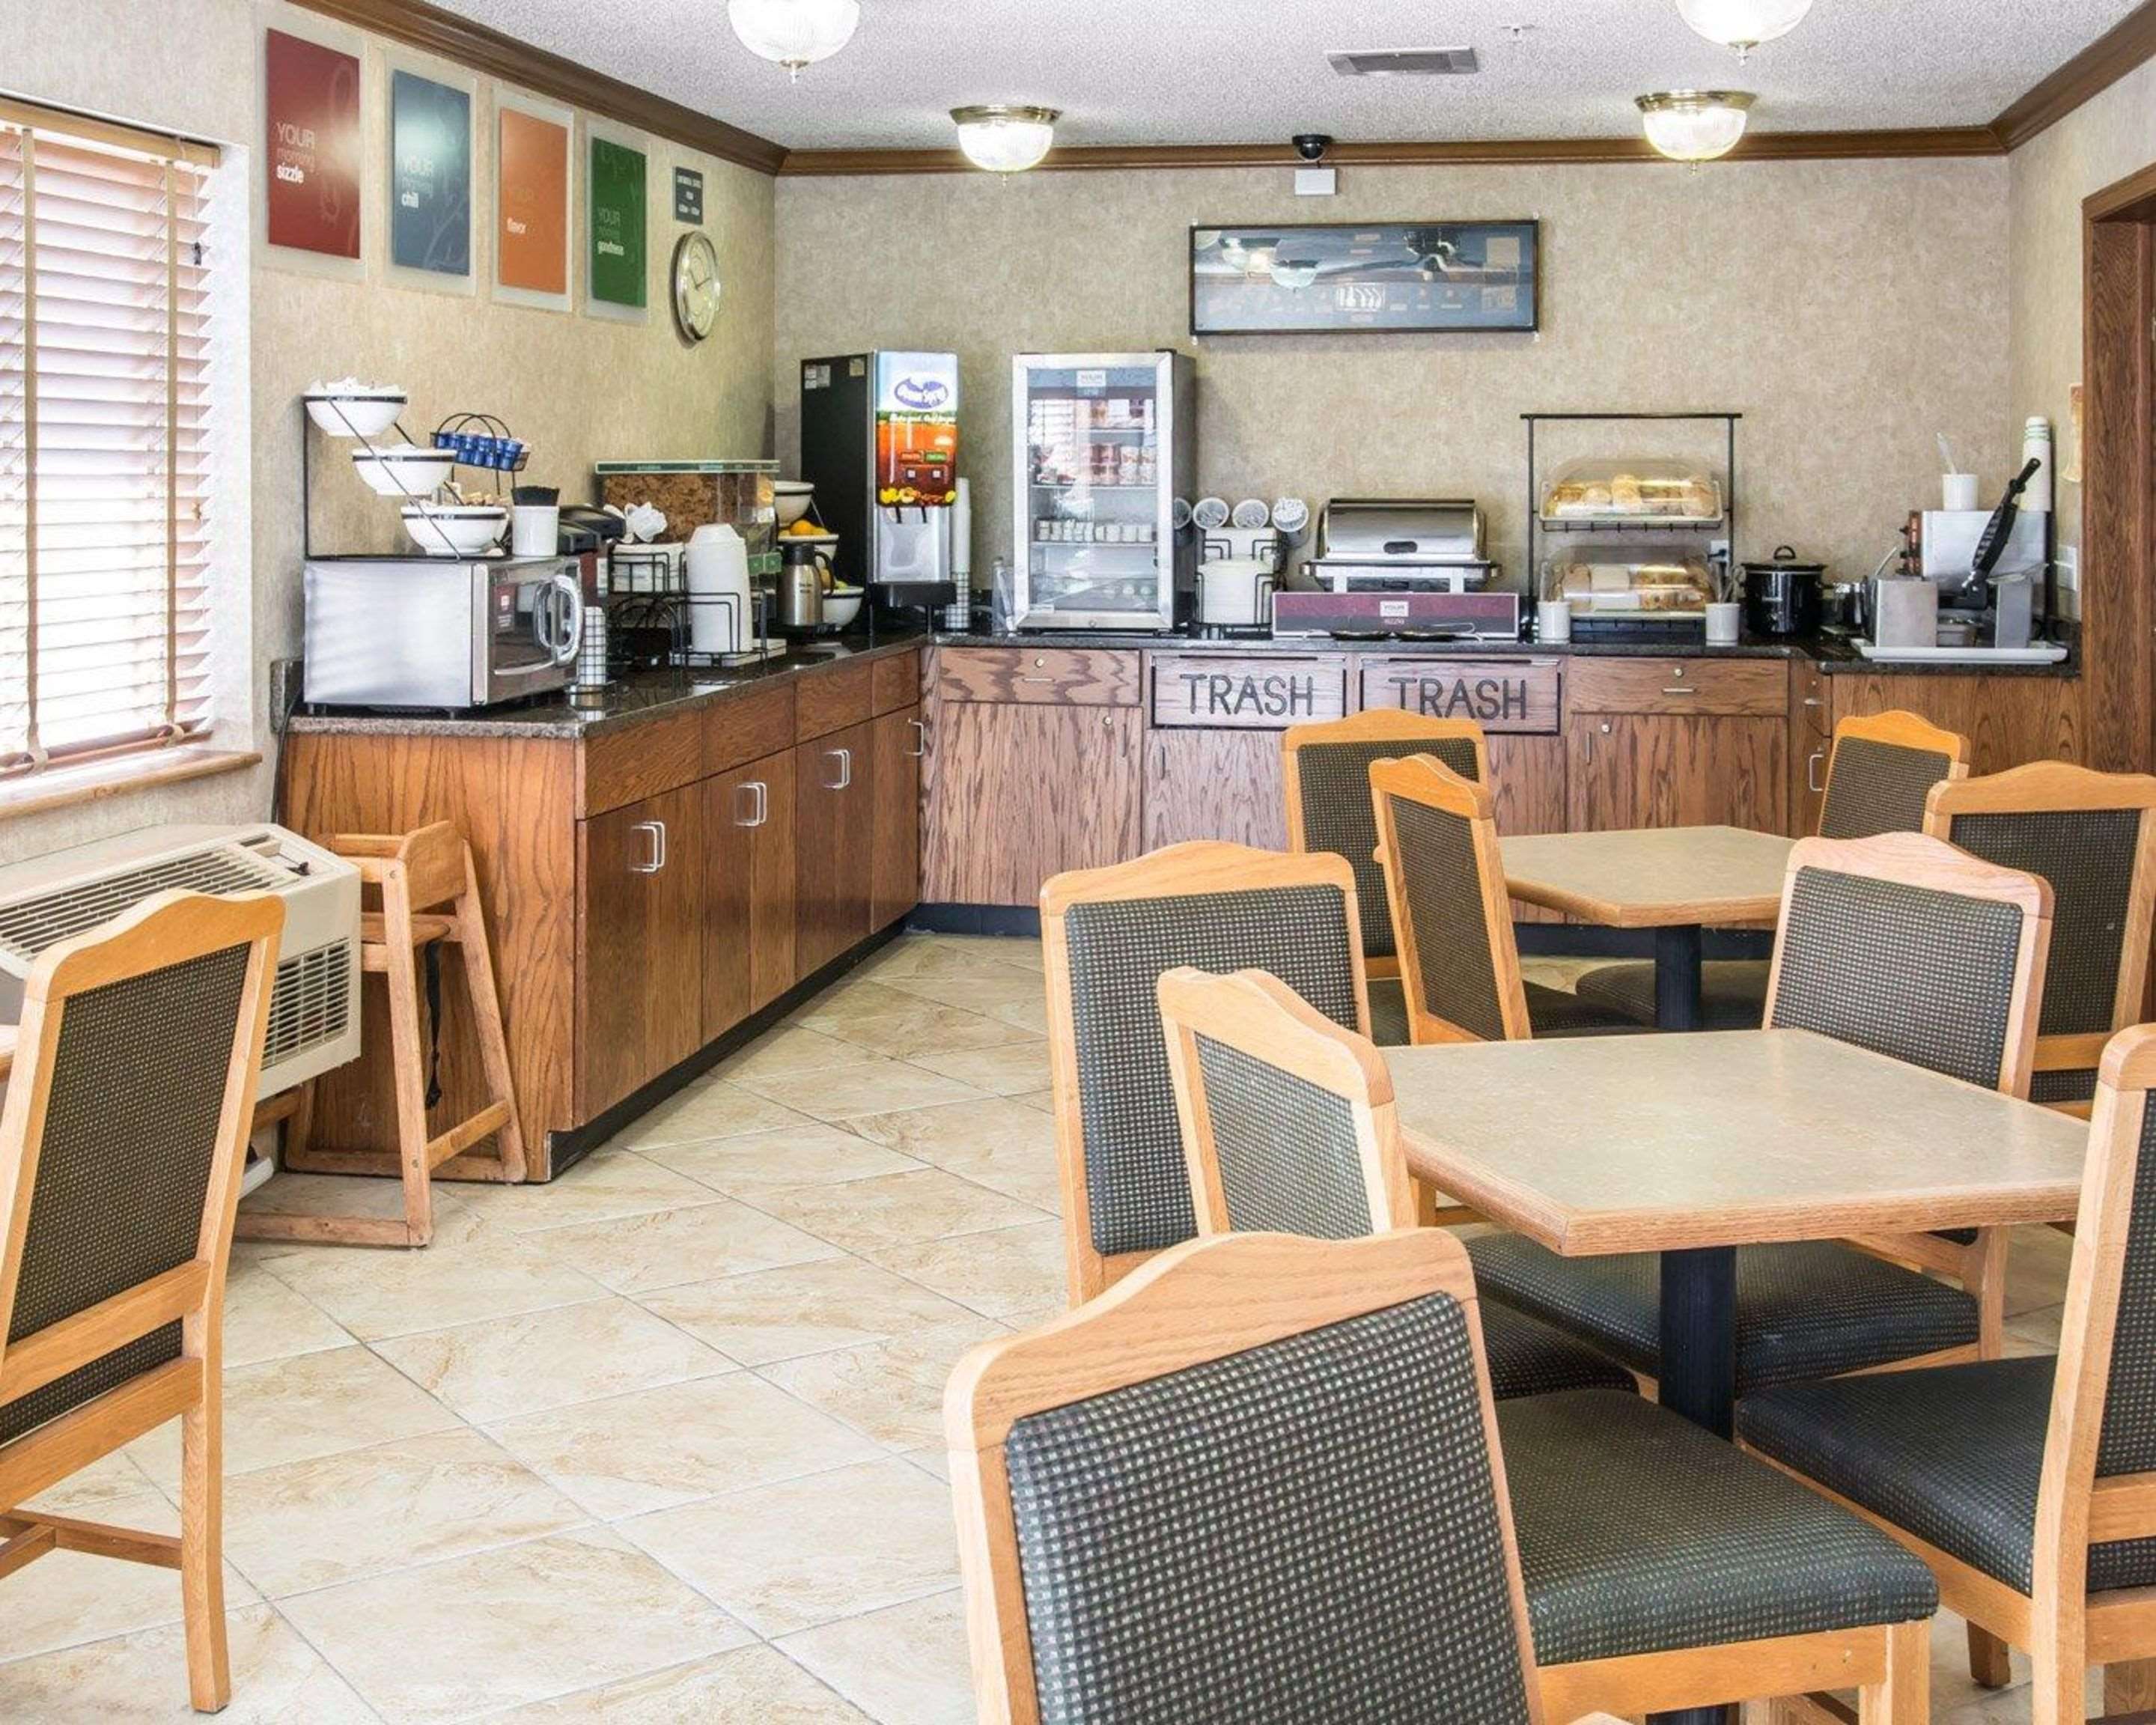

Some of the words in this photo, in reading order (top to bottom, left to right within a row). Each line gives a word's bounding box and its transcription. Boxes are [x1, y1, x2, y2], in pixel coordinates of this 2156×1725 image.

[275, 121, 316, 150] YOUR
[276, 162, 305, 184] sizzle
[401, 191, 419, 209] chill
[1180, 674, 1313, 716] TRASH
[1389, 677, 1526, 719] TRASH
